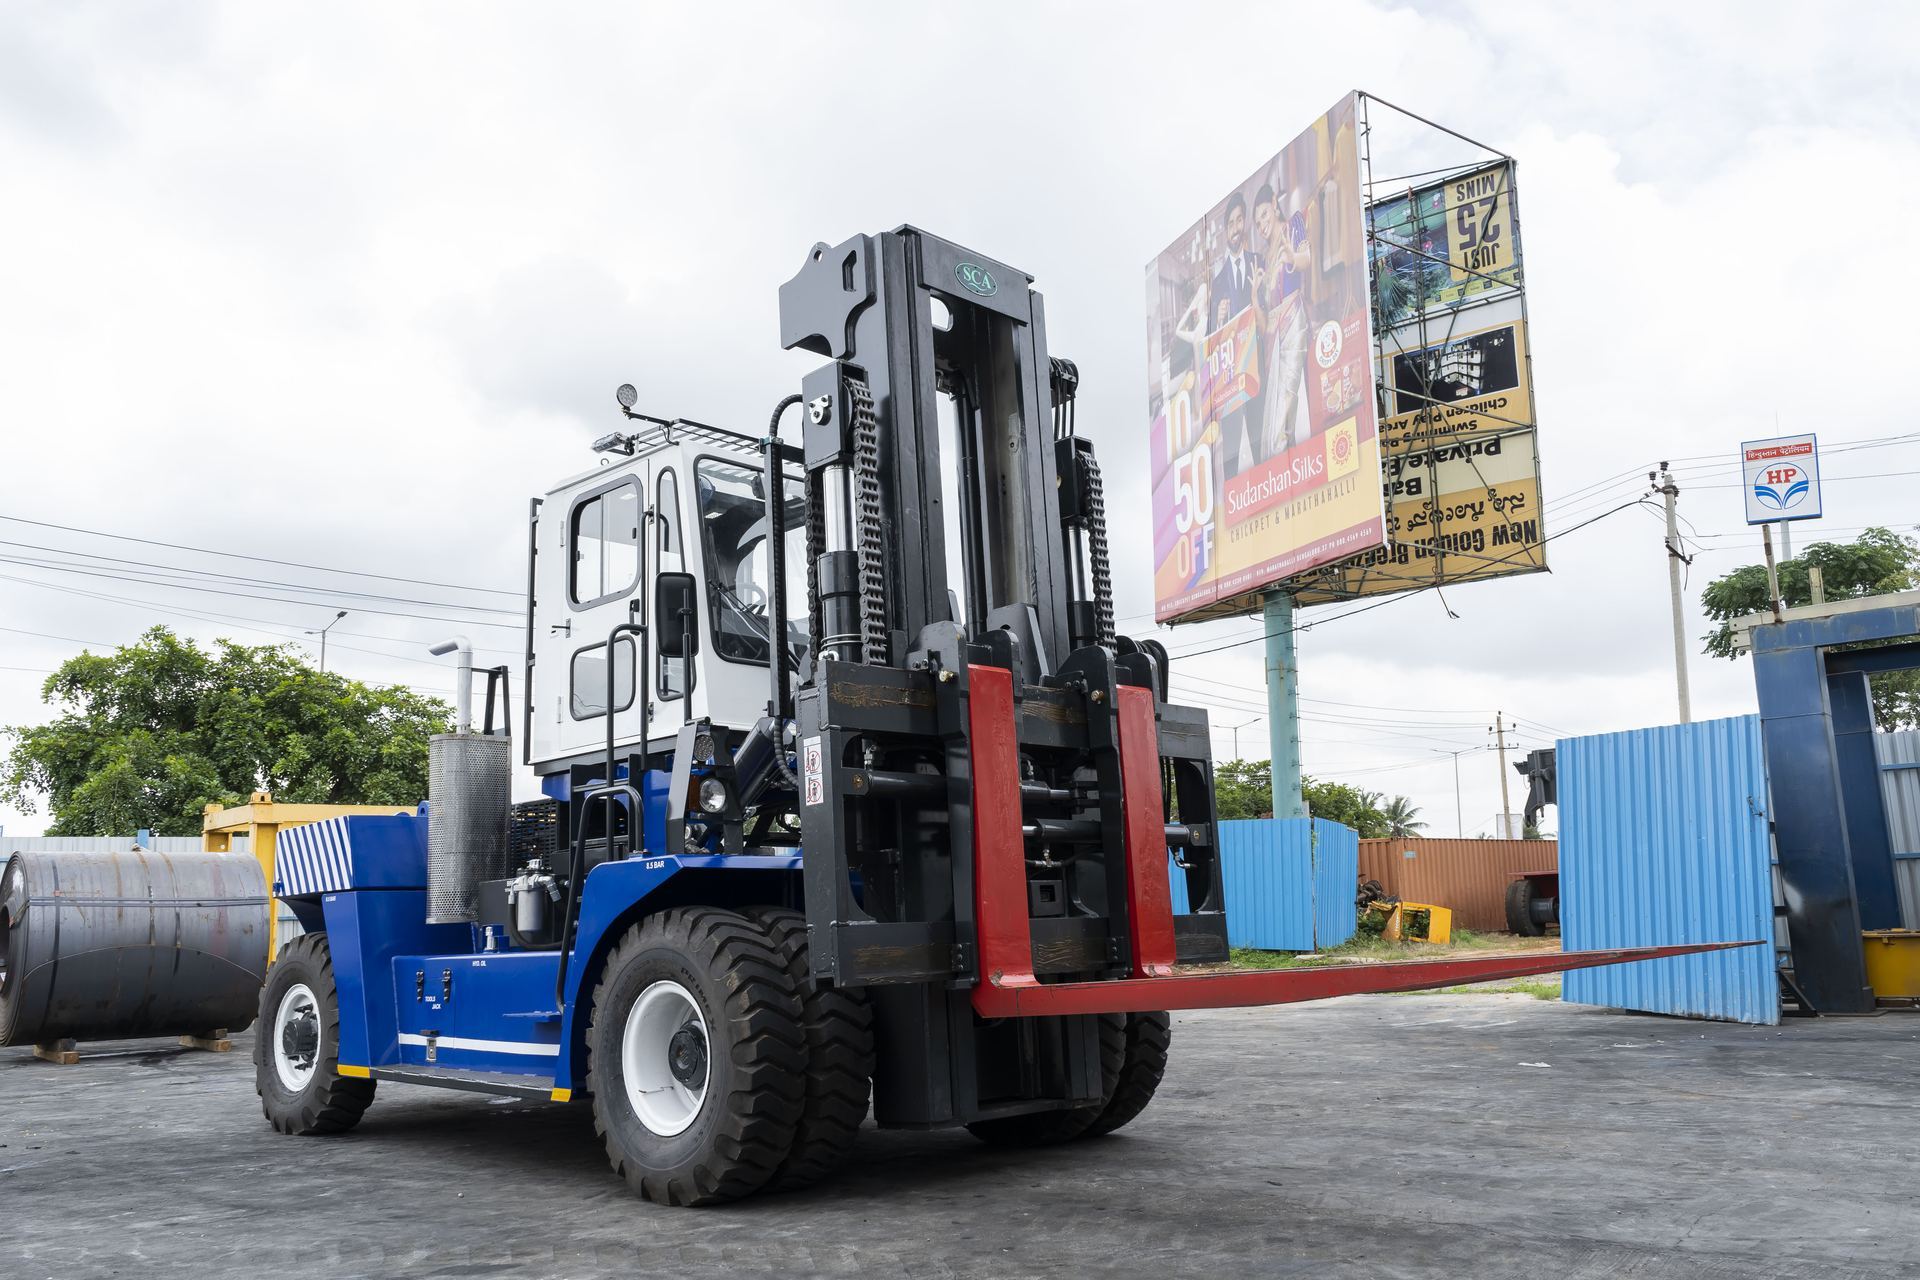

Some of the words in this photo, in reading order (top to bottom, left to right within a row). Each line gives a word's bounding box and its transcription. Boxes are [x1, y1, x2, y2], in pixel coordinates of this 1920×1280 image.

[1457, 174, 1495, 202] MINS
[1457, 198, 1501, 251] 25
[1464, 243, 1500, 272] JUST
[963, 265, 992, 290] SCA
[1413, 413, 1443, 427] Play
[1446, 397, 1508, 418] Children
[1408, 438, 1502, 468] Private
[1173, 443, 1214, 534] 50
[1228, 468, 1291, 515] Sudarshan
[1292, 454, 1323, 485] Silks
[1766, 468, 1797, 485] HP
[1230, 514, 1270, 544] CHICKPET
[1284, 477, 1356, 520] MARATHAHALLI
[1415, 528, 1485, 560] Golden
[1492, 519, 1537, 547] New
[1177, 522, 1215, 579] OFF
[654, 860, 665, 869] BAR
